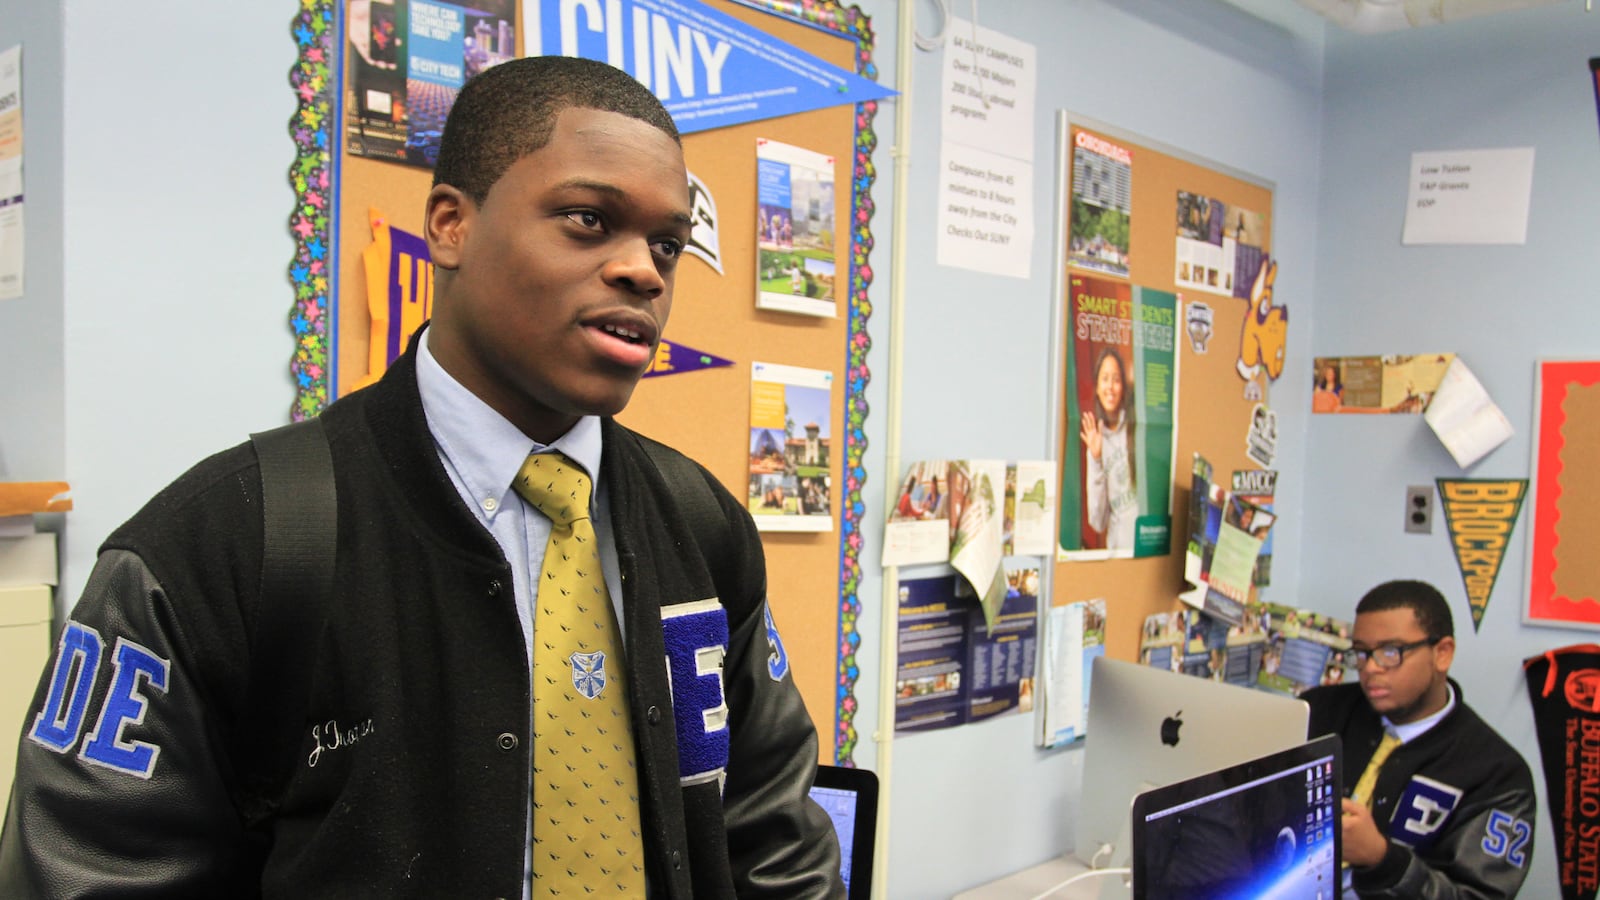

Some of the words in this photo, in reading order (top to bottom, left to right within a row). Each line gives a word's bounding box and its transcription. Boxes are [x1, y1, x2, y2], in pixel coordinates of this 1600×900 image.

[953, 59, 970, 71] Over
[986, 169, 1004, 182] from
[1077, 294, 1118, 316] SMART
[1120, 301, 1173, 326] STDENTS
[1077, 312, 1132, 346] START
[1443, 481, 1521, 608] BROCKPORT
[1580, 718, 1600, 818] BUFFALO
[1481, 808, 1531, 869] 52
